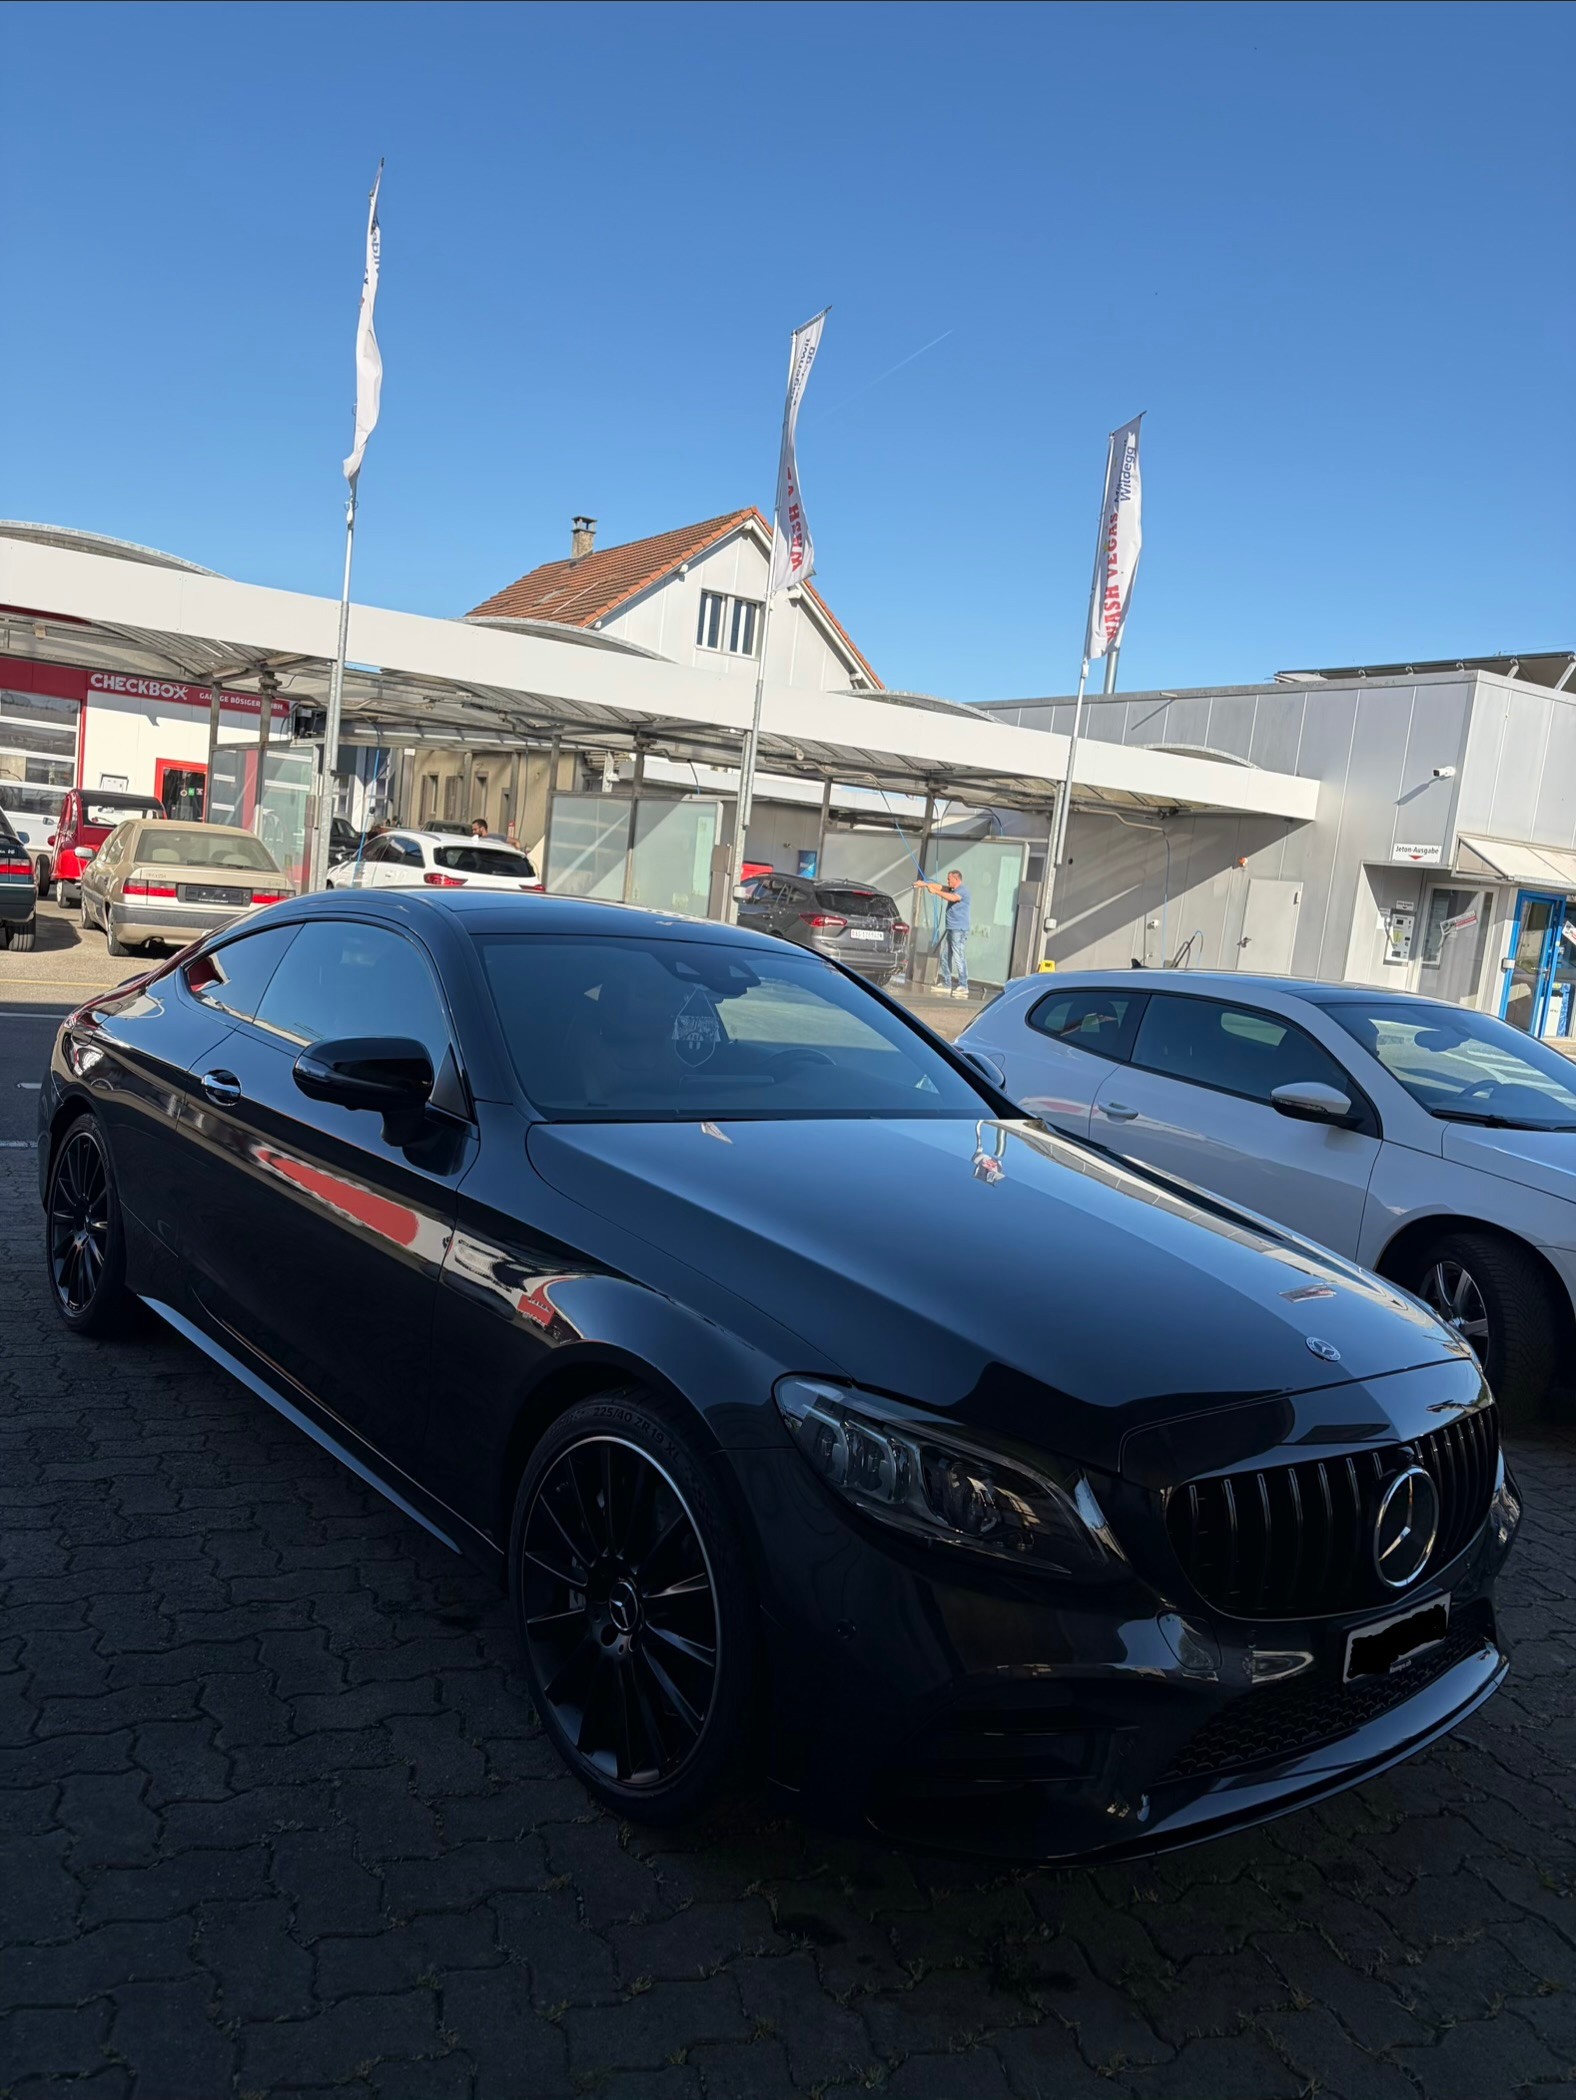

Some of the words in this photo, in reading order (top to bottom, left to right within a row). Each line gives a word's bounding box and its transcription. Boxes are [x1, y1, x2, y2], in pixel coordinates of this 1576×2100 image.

[1120, 446, 1136, 502] Wildegg
[788, 503, 803, 572] WASH
[1106, 511, 1119, 583] VEGAS
[1103, 584, 1121, 644] WASH
[90, 673, 188, 701] CHECKBOX
[230, 695, 261, 708] BÖSIGER
[1395, 845, 1439, 856] Jeton-Ausgabe
[593, 1407, 633, 1423] 225/40
